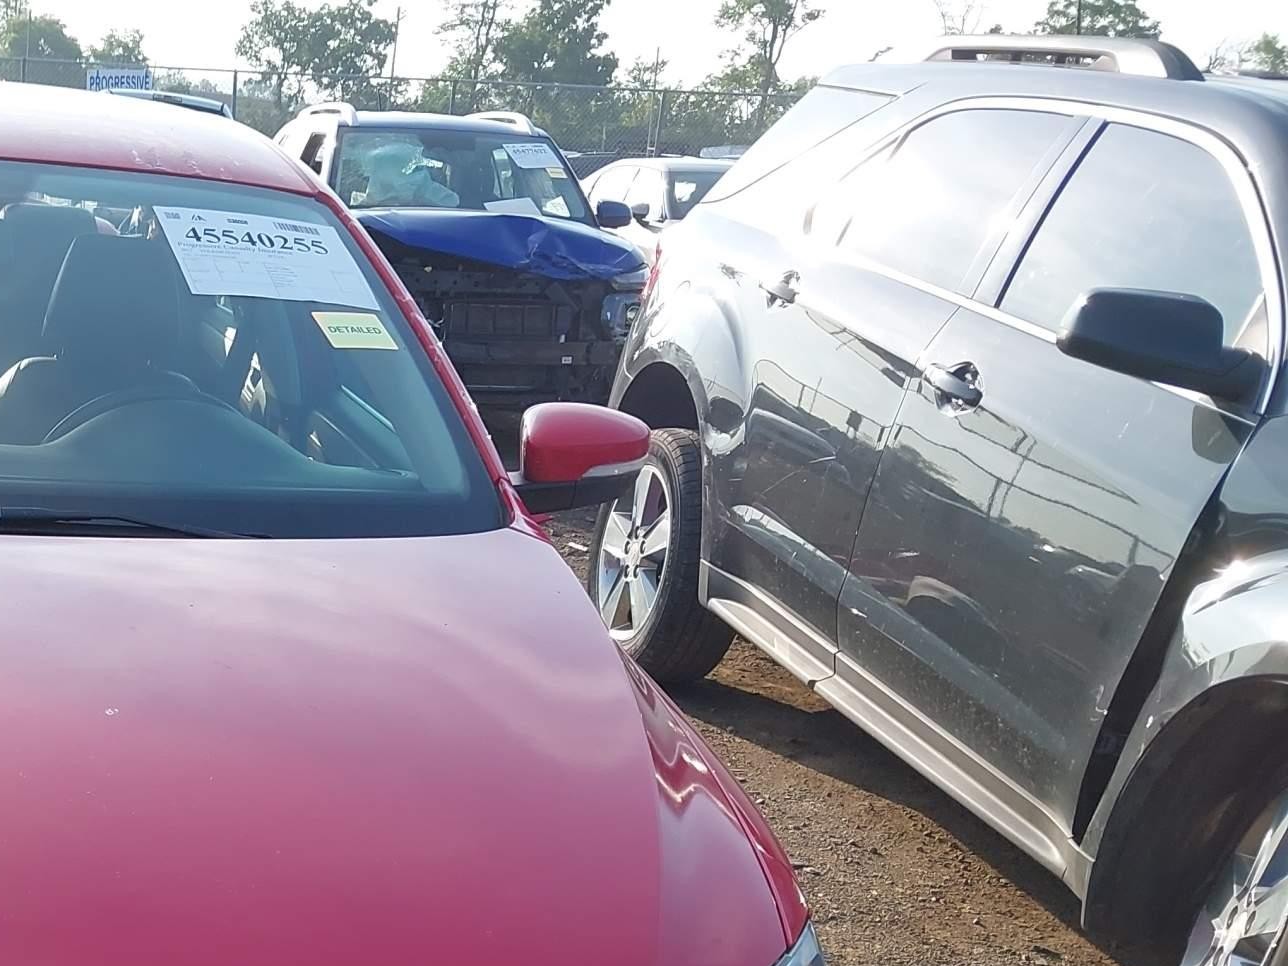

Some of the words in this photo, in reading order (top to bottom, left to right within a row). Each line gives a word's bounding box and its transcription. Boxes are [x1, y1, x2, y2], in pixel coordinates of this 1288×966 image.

[89, 75, 150, 91] PROGRESSIVE
[186, 227, 328, 255] 45540255
[328, 326, 382, 335] DETAILED
